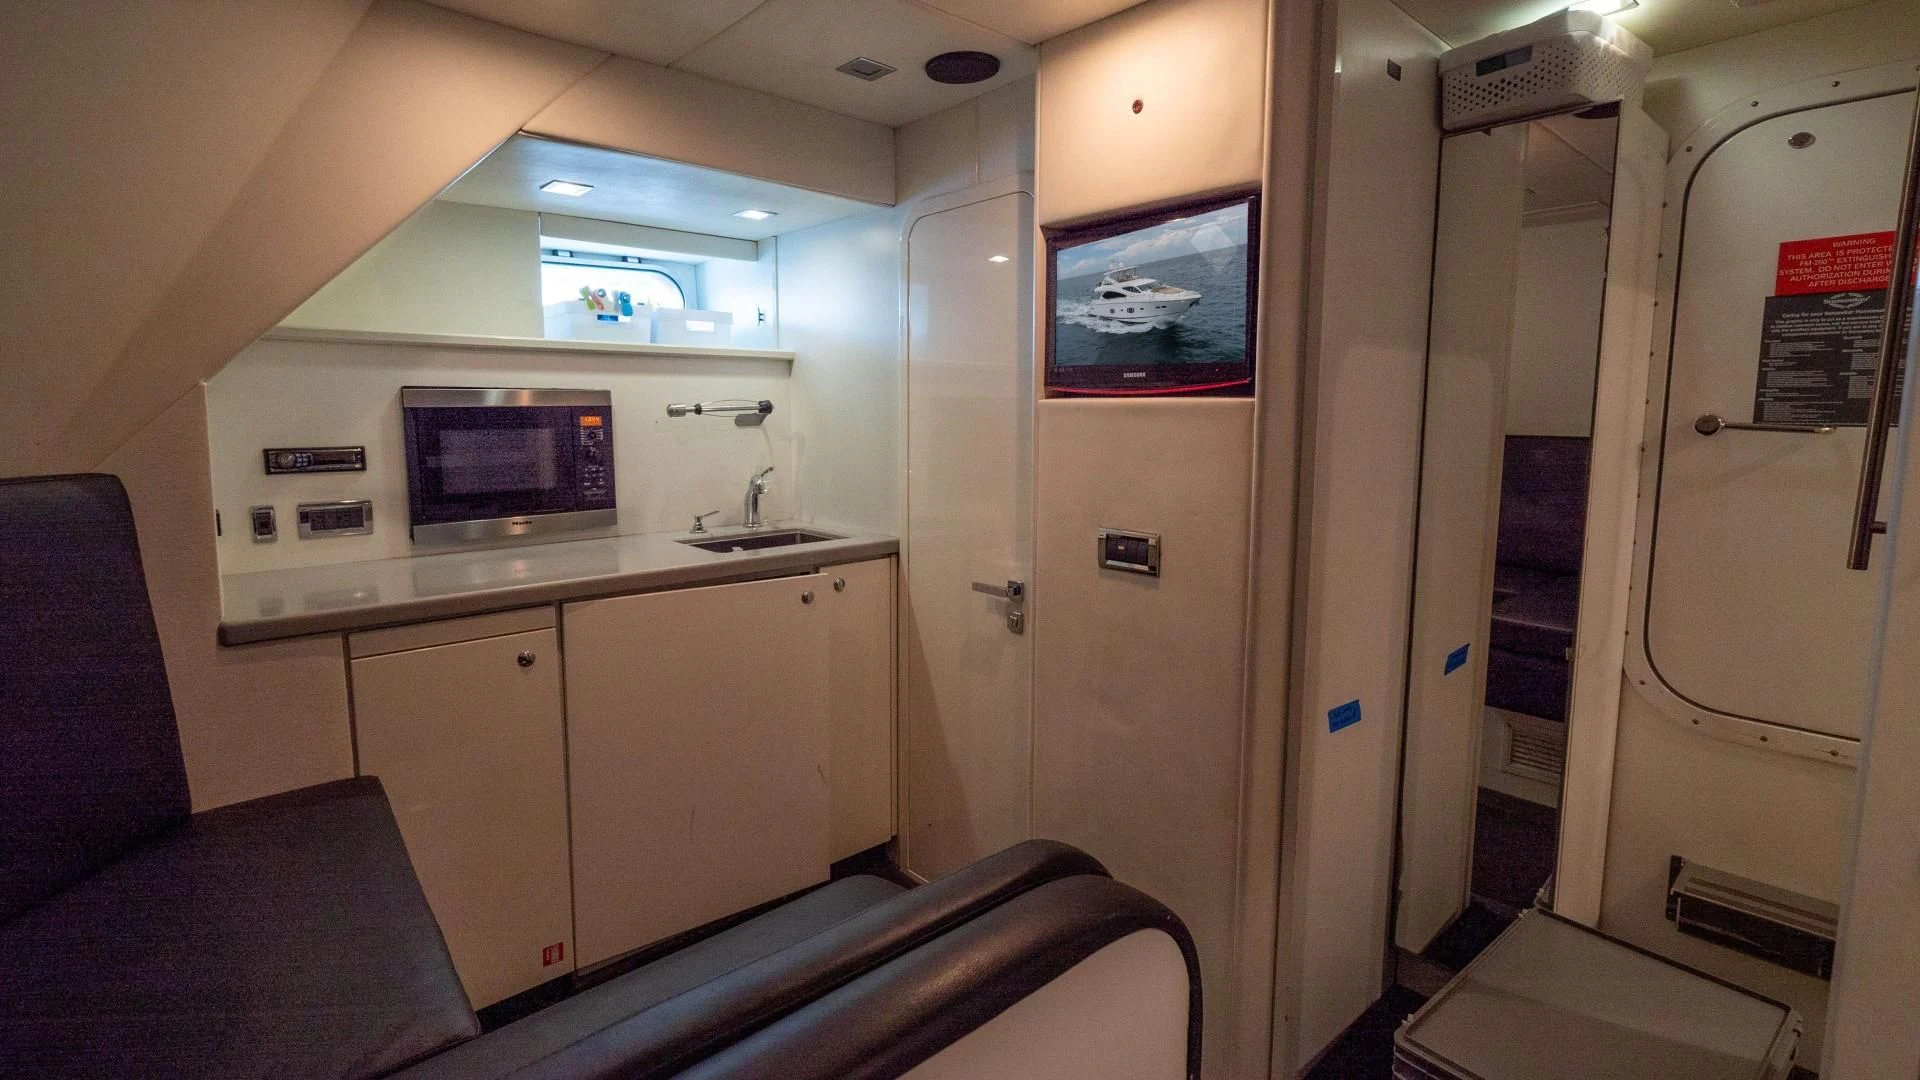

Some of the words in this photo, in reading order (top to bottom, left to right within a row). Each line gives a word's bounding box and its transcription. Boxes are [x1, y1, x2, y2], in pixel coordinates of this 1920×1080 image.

[1832, 238, 1876, 248] WARNING
[1788, 253, 1806, 261] THIS
[1808, 251, 1832, 259] AREA
[1847, 245, 1893, 255] PROTECTE
[1836, 253, 1892, 264] EXTINGUISH
[1818, 265, 1832, 273] DO
[1833, 263, 1851, 272] NOT
[1854, 261, 1880, 270] ENTER
[1790, 271, 1860, 282] AUTHORIZATION
[1863, 267, 1891, 276] DURIN
